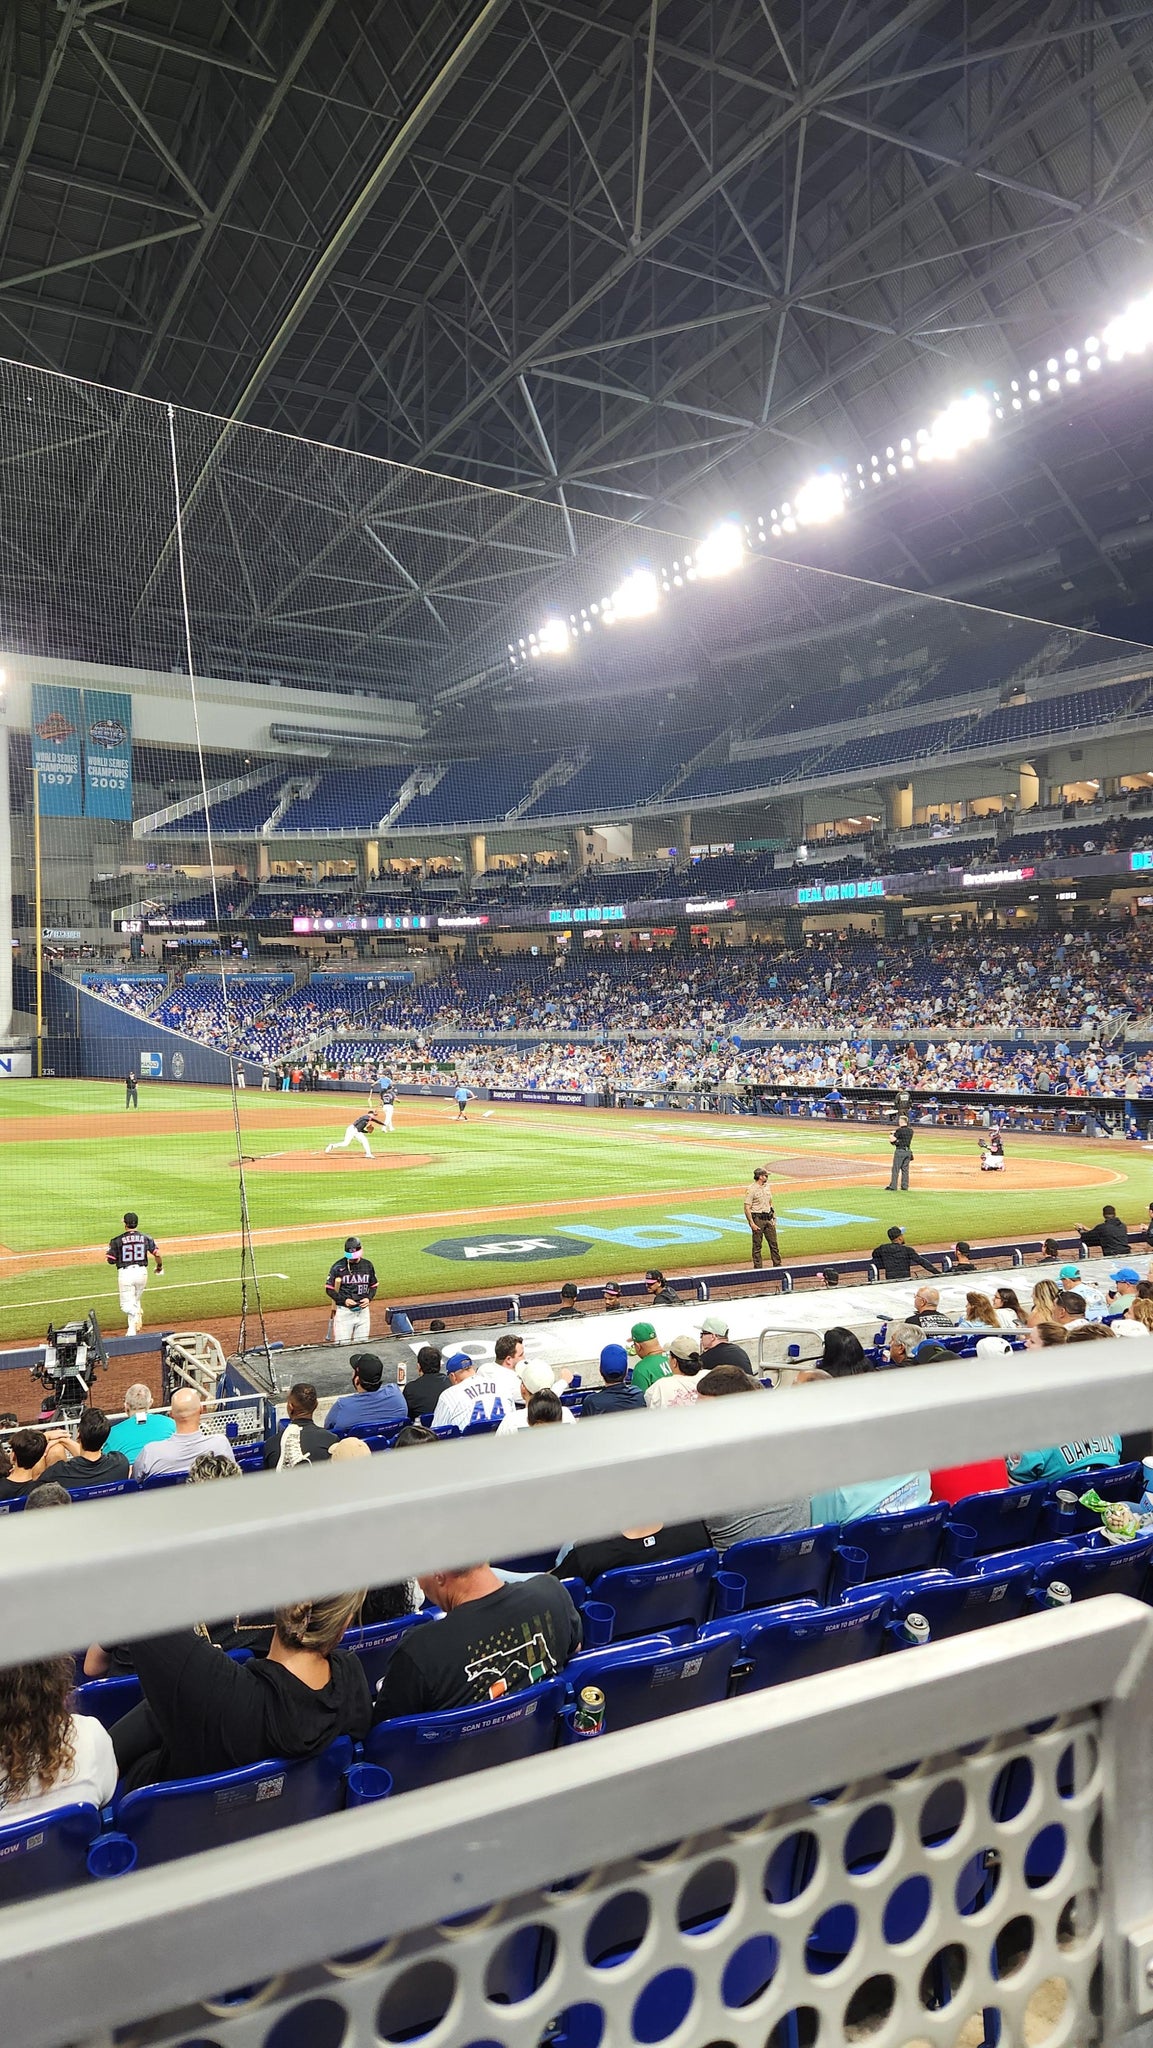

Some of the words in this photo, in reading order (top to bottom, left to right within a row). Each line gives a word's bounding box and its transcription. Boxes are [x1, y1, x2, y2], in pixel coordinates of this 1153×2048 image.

[35, 752, 56, 763] WORLD
[57, 753, 78, 764] SERIES
[88, 756, 107, 767] WORLD
[108, 758, 129, 769] SERIES
[35, 762, 78, 774] CHAMPIONS
[87, 766, 129, 779] CHAMPIONS
[41, 773, 73, 785] 1997
[91, 777, 126, 789] 2003
[797, 887, 824, 903] DEAL
[824, 885, 840, 900] OR
[840, 883, 857, 899] NO
[857, 880, 886, 898] DEAL
[549, 909, 573, 923] DEAL
[573, 907, 588, 921] OR
[588, 907, 602, 920] NO
[602, 905, 625, 920] DEAL
[121, 921, 141, 932] 8:57
[42, 1068, 55, 1076] 335
[122, 1243, 145, 1262] 68
[463, 1238, 558, 1259] ADT
[464, 1382, 497, 1400] RIZZO
[825, 1624, 840, 1632] SCAN
[840, 1621, 848, 1629] TO
[848, 1618, 859, 1627] BET
[373, 1638, 384, 1646] BET
[461, 1722, 481, 1734] SCAN
[482, 1719, 492, 1729] TO
[492, 1716, 506, 1726] BET
[506, 1709, 523, 1721] NOW
